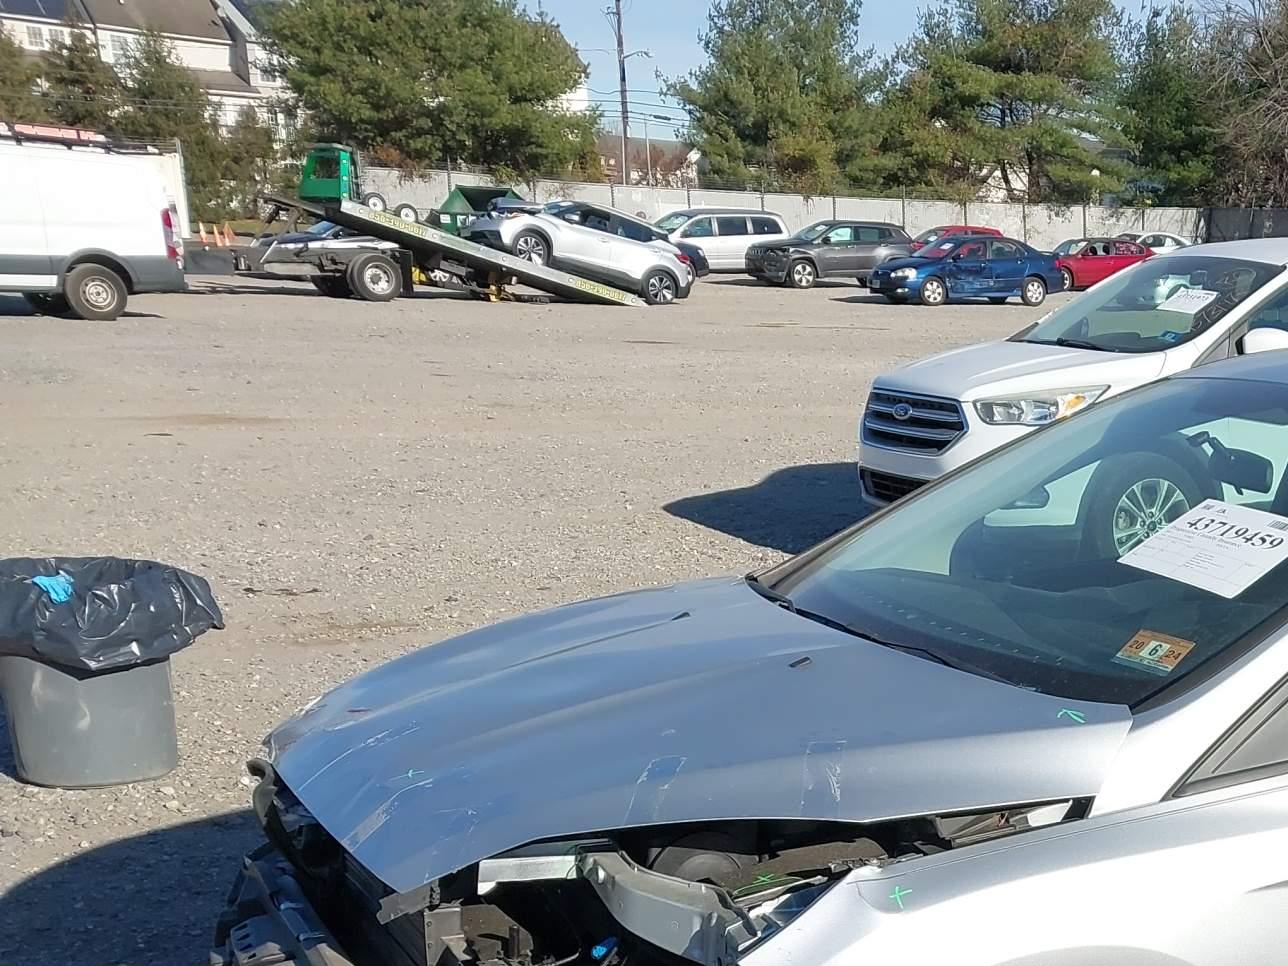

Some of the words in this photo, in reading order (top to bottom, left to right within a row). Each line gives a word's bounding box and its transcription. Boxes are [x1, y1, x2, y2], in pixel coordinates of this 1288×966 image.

[1187, 516, 1284, 550] 43719459
[1128, 640, 1145, 650] 20
[1149, 643, 1162, 656] 6
[1164, 650, 1182, 660] 24
